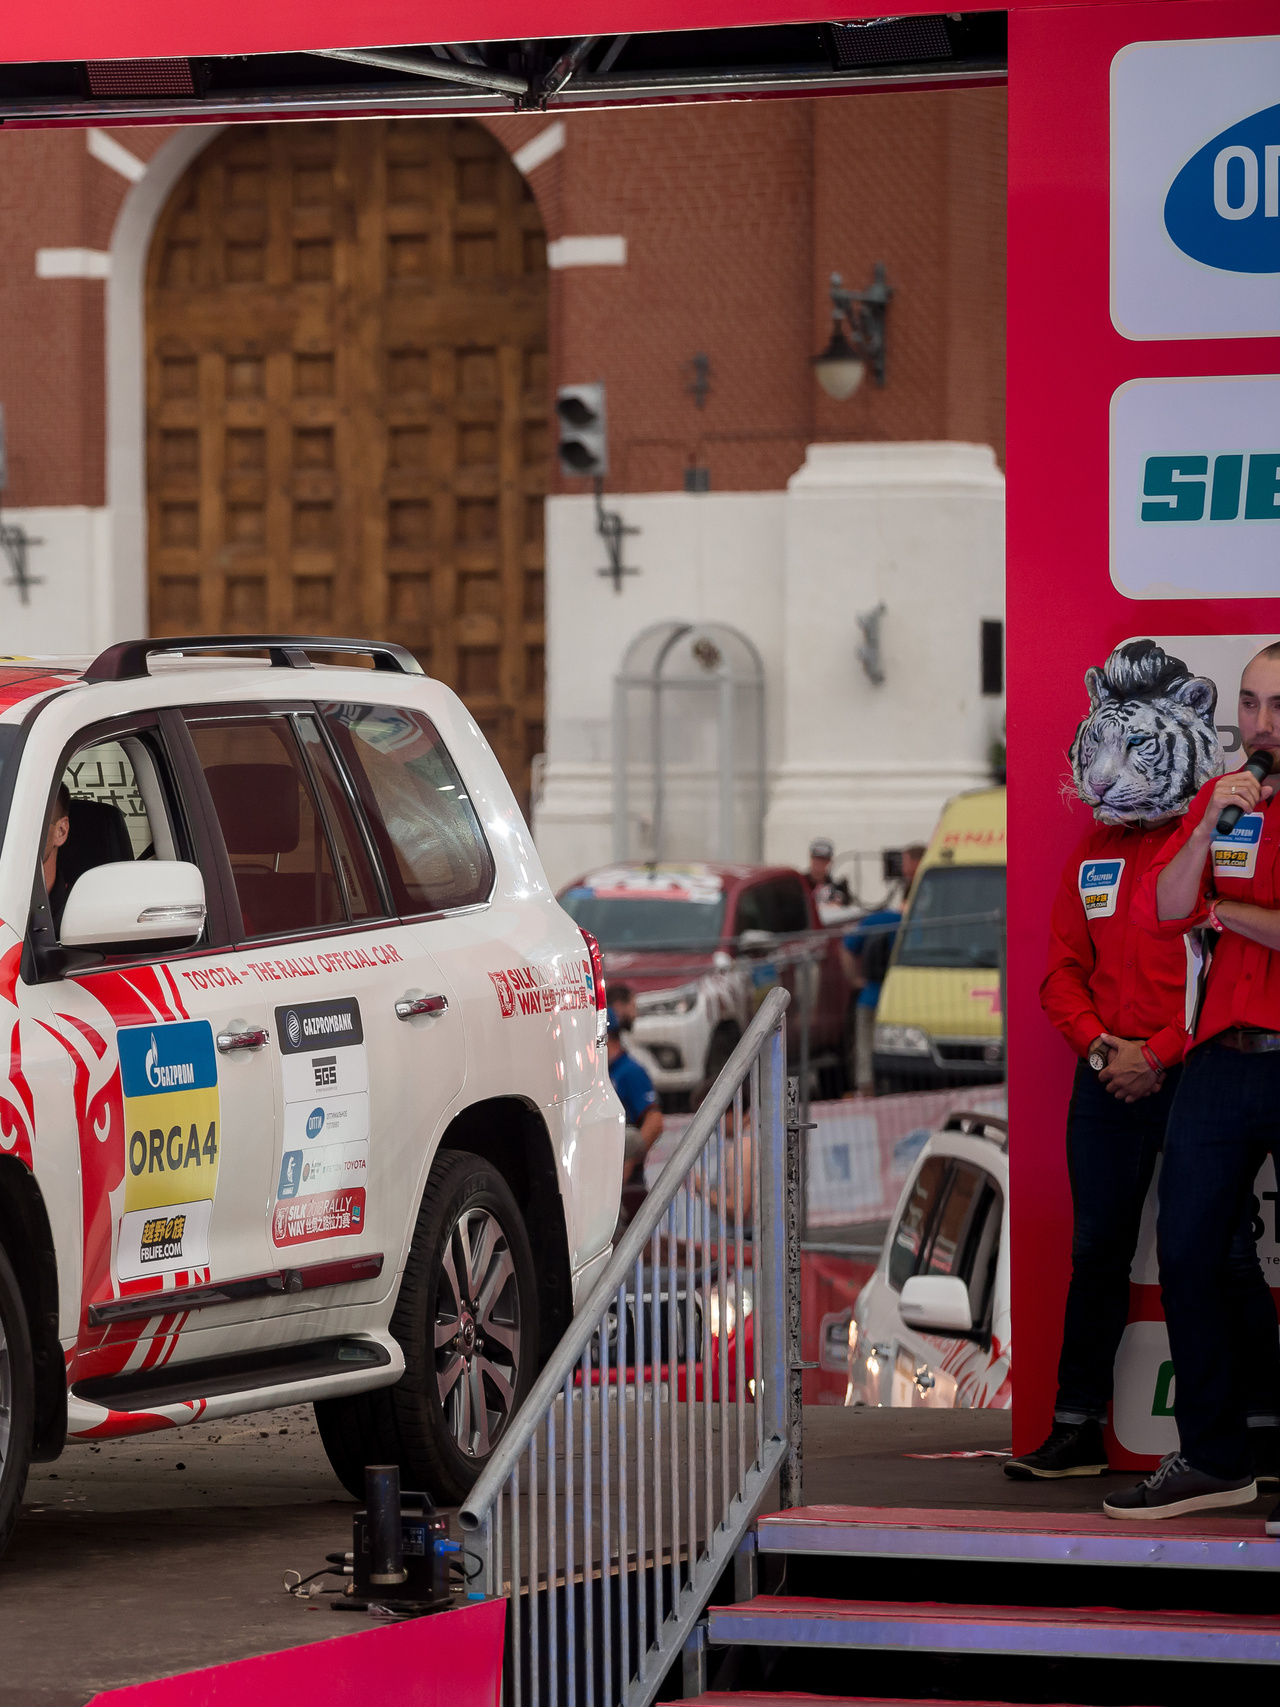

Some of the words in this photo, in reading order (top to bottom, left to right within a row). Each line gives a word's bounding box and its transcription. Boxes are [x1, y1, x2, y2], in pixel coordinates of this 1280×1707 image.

[182, 967, 244, 991] TOYOTA
[247, 961, 282, 982] THE
[275, 955, 320, 979] RALLY
[317, 948, 378, 973] OFFICIAL
[372, 943, 404, 965] CAR
[507, 967, 539, 991] SILK
[517, 990, 542, 1016] WAY
[302, 1013, 353, 1036] GAZPROMBANK
[160, 1063, 195, 1087] GAZPROM
[314, 1066, 337, 1087] SGS
[128, 1121, 218, 1177] ORGA4
[344, 1159, 367, 1171] TOYOTA
[288, 1203, 308, 1221] SILK
[323, 1196, 353, 1215] RALLY
[287, 1219, 306, 1238] WAY
[141, 1241, 183, 1262] FBLIFE.COM
